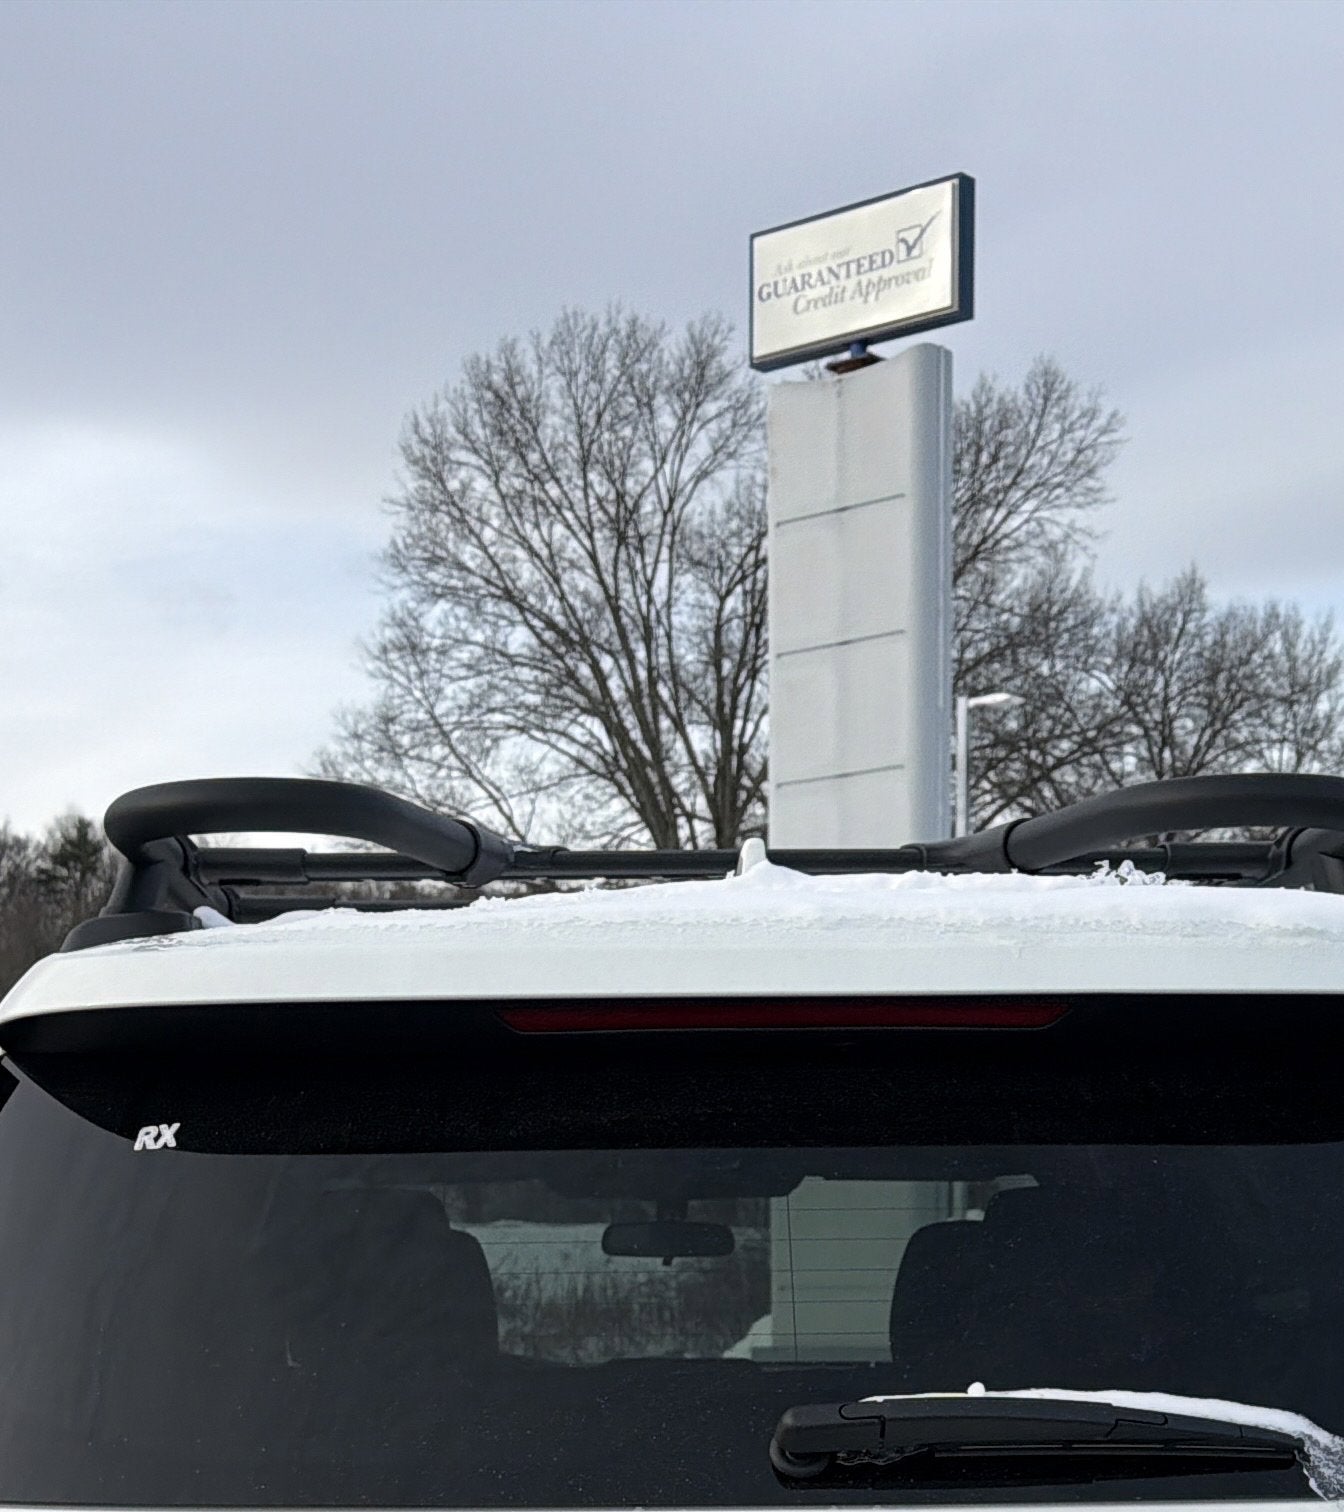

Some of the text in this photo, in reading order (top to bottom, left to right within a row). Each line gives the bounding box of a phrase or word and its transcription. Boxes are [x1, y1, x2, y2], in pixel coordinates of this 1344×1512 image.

[758, 249, 894, 302] GUARANTEED
[793, 258, 933, 314] Credit Approval
[134, 1122, 181, 1151] RX
